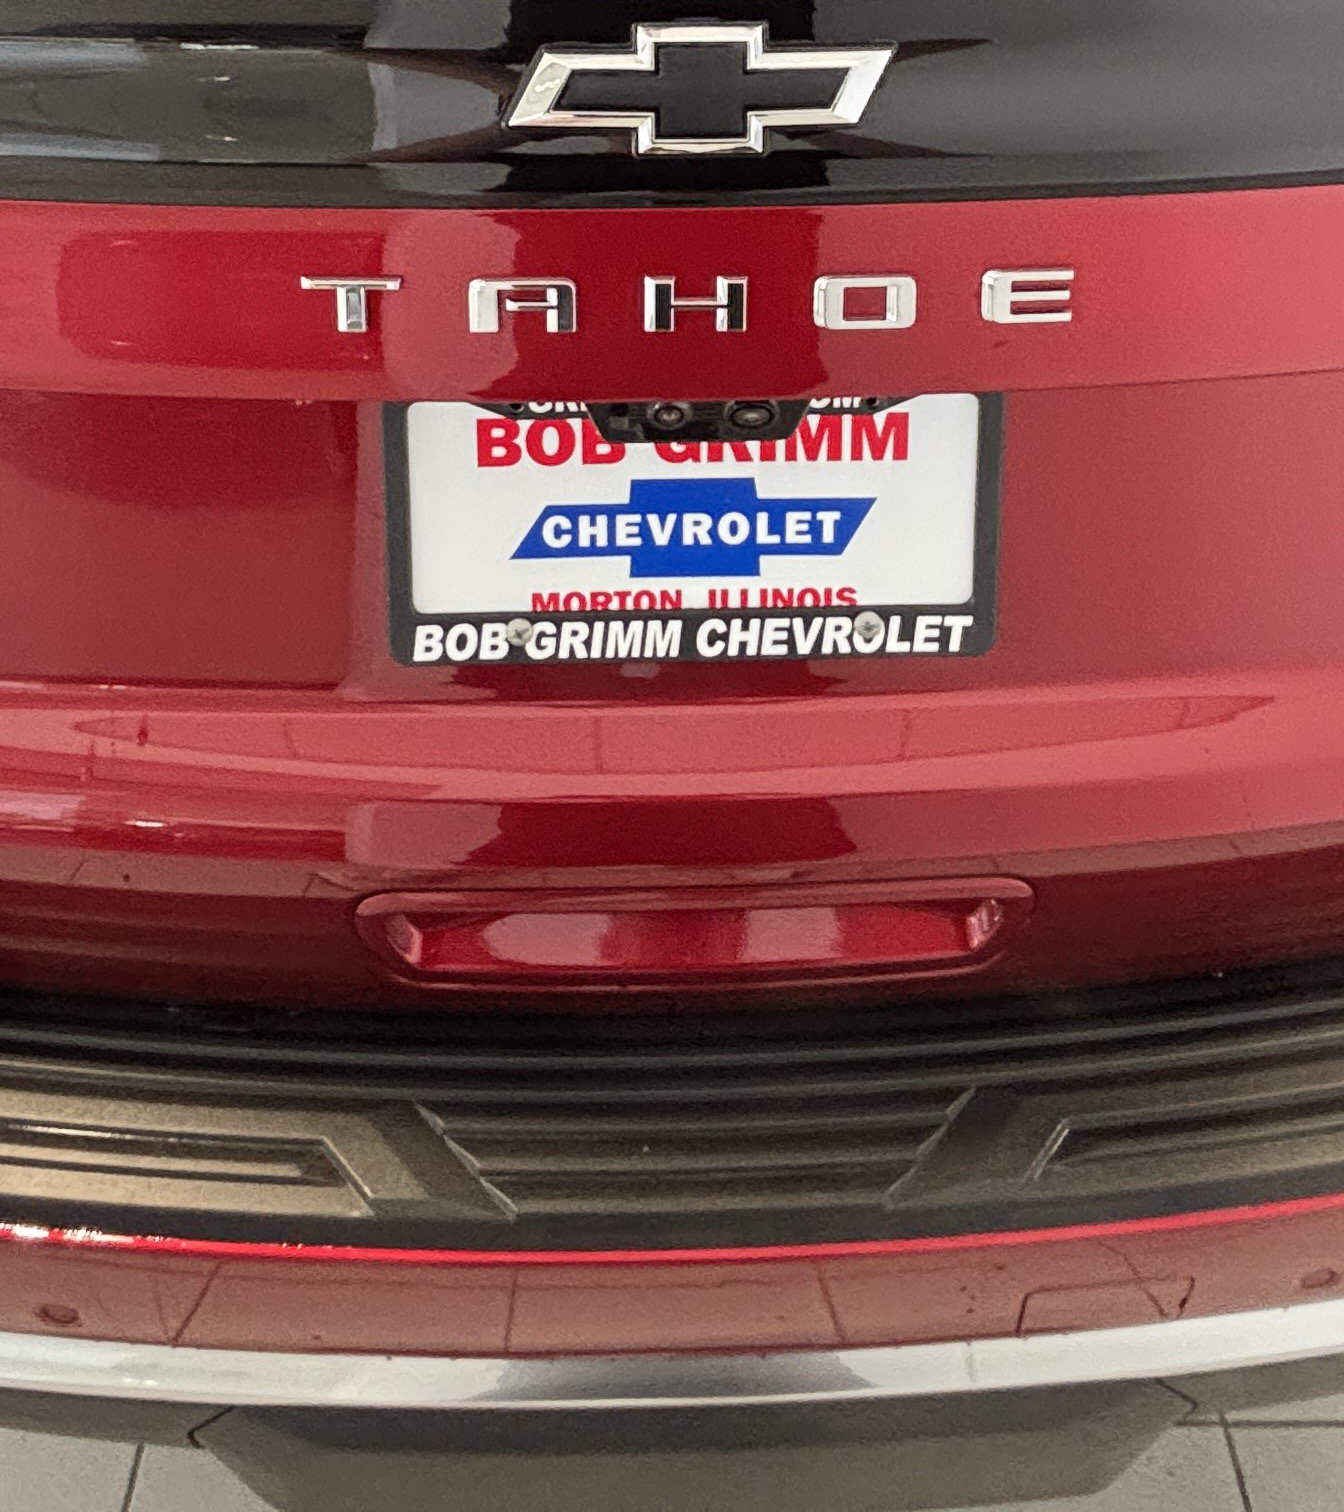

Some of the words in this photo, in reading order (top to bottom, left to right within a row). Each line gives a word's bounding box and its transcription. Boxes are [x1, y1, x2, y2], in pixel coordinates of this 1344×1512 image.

[299, 267, 1076, 334] TAHOE
[476, 417, 626, 467] BOB
[541, 510, 842, 549] CHEVROLET
[531, 589, 683, 613] MORTON
[708, 586, 858, 609] ILLINOIS
[412, 622, 509, 663] BOB
[525, 619, 683, 661] GRIMM
[695, 614, 974, 658] CHEVROLET
